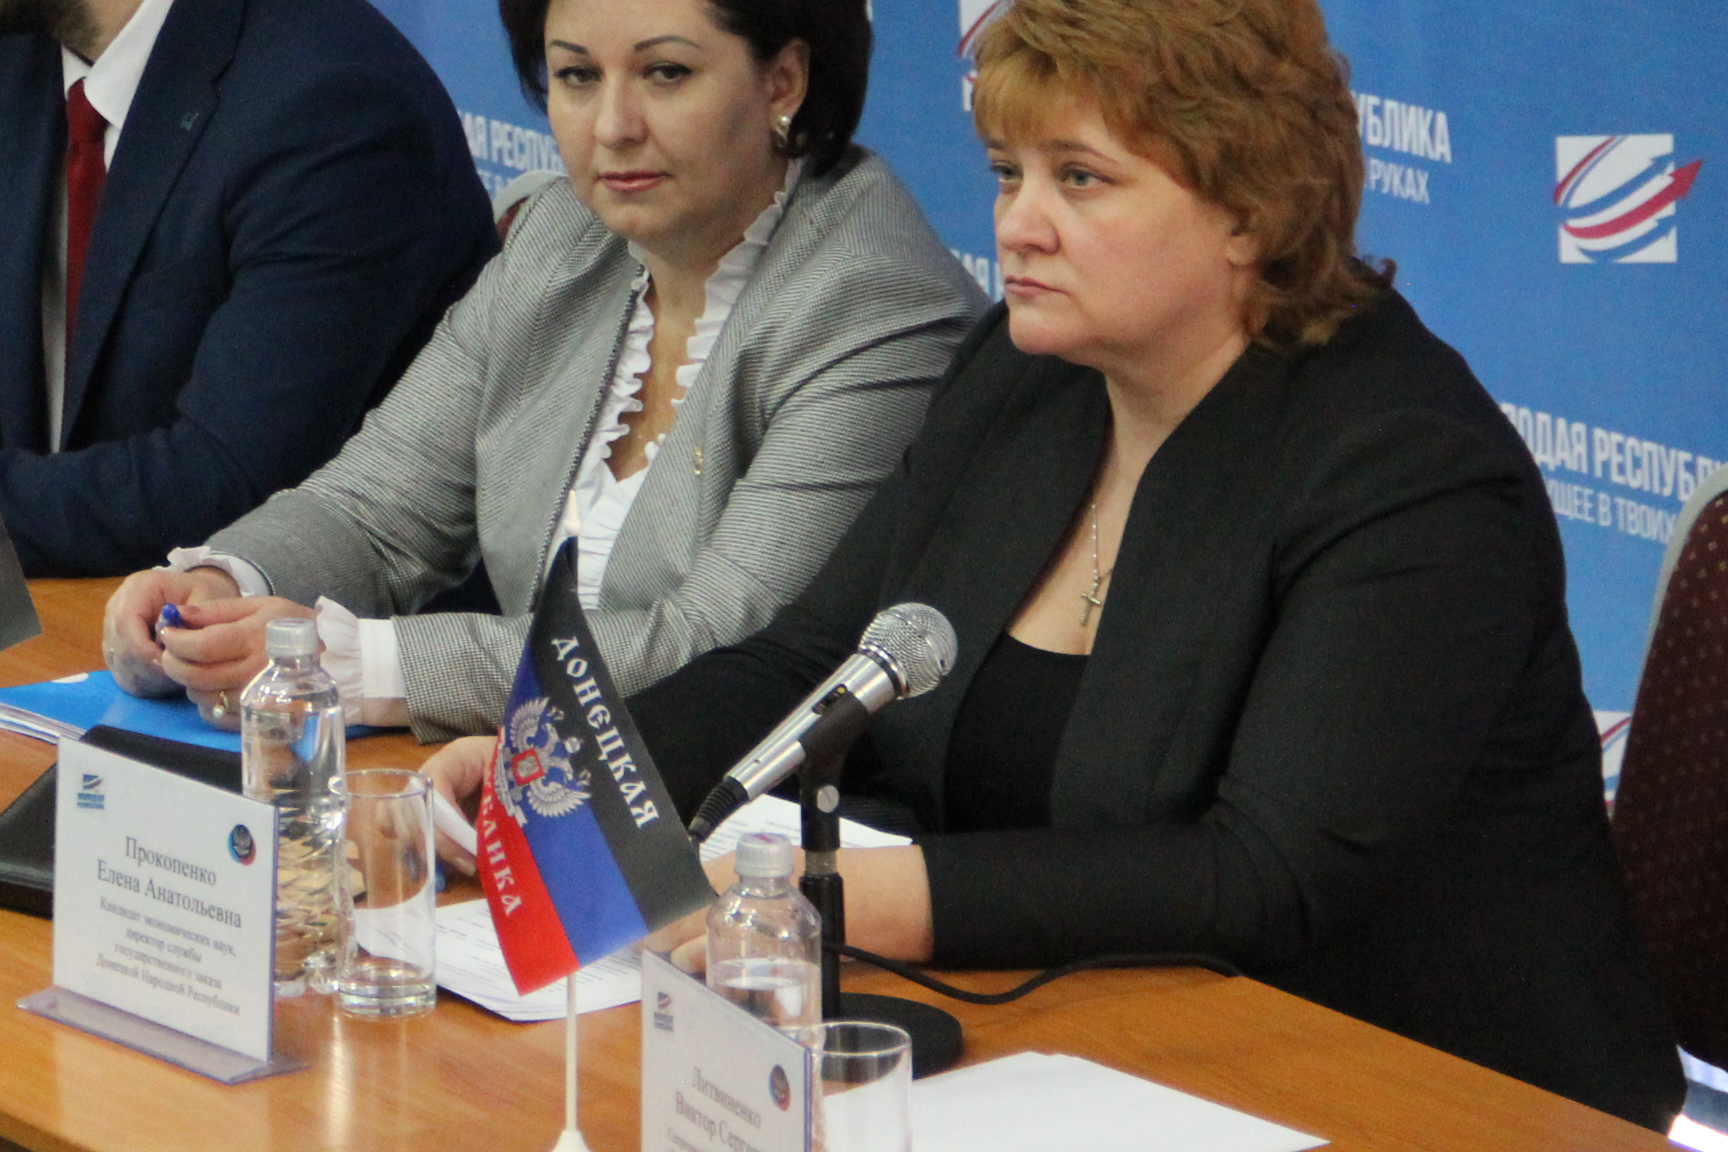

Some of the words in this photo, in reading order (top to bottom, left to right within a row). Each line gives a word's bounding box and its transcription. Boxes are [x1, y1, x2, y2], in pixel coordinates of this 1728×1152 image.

[1370, 157, 1430, 204] РУКАХ
[1598, 493, 1612, 527] В
[551, 636, 660, 828] ДОНЕЦКАЯ
[125, 836, 217, 887] Прокопенко
[97, 859, 141, 894] Елена
[144, 878, 242, 928] Анатольевна
